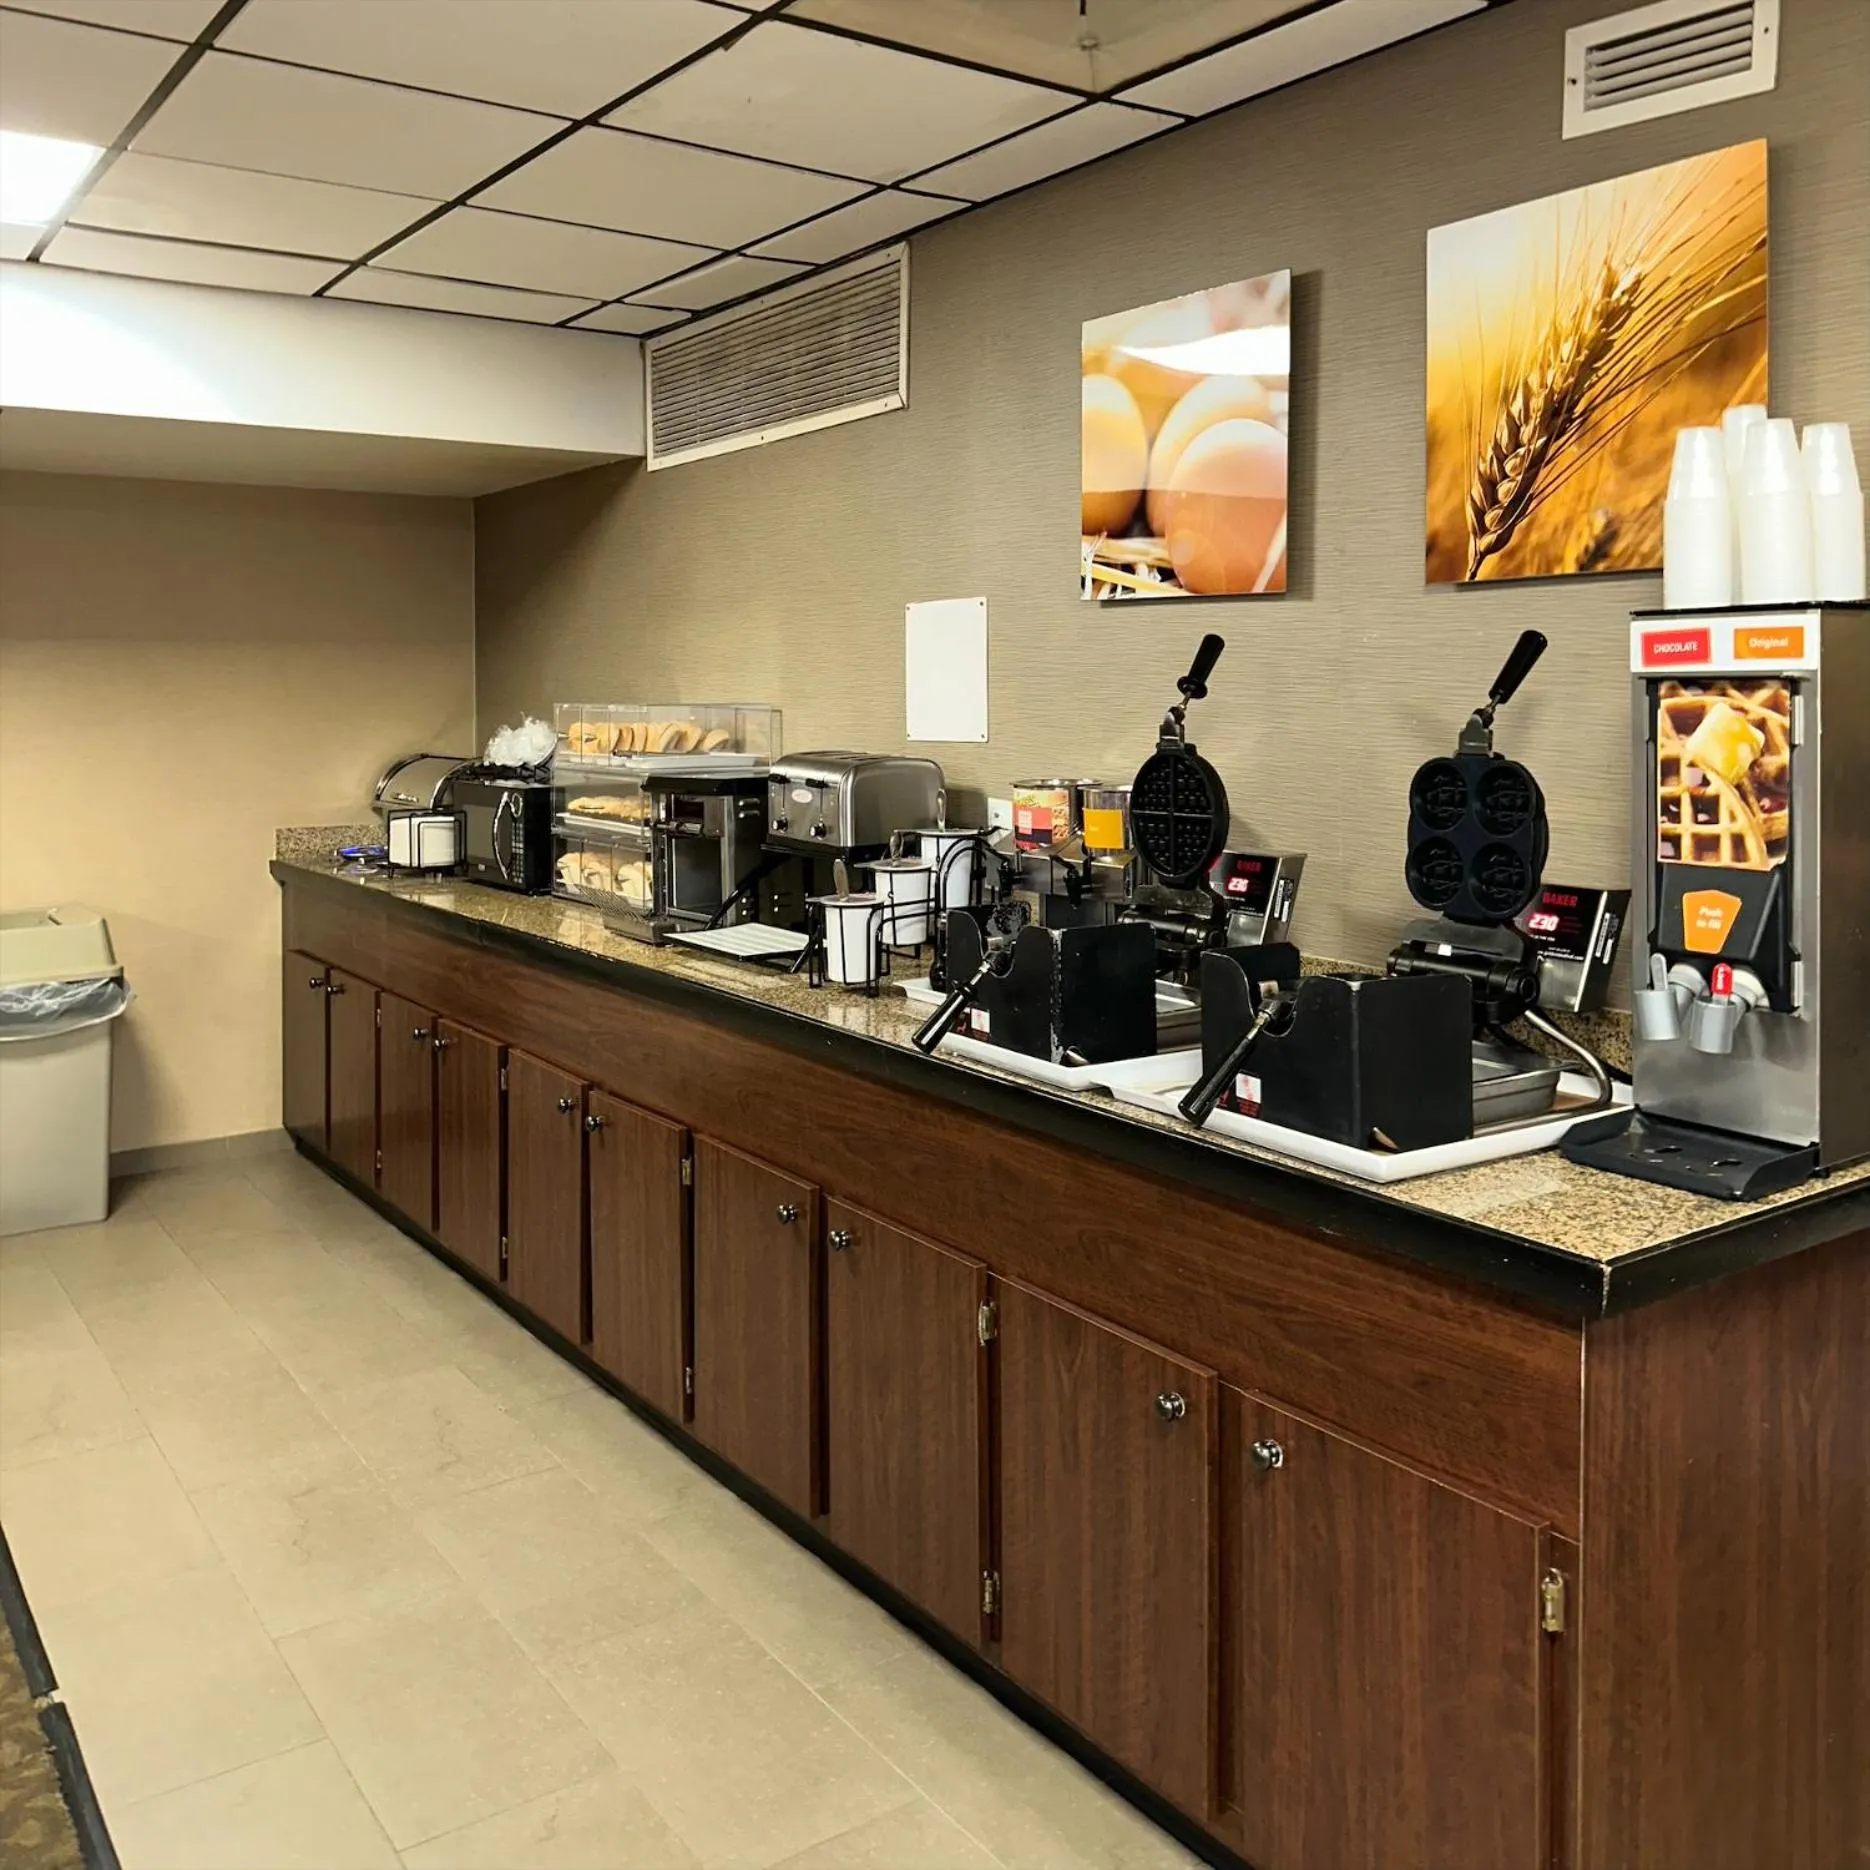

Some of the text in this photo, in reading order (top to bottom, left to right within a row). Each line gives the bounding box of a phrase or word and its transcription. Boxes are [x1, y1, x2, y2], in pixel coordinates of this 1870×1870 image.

[1653, 640, 1699, 655] CHOCOLATE
[1748, 636, 1789, 651] Original
[1528, 912, 1560, 931] 230
